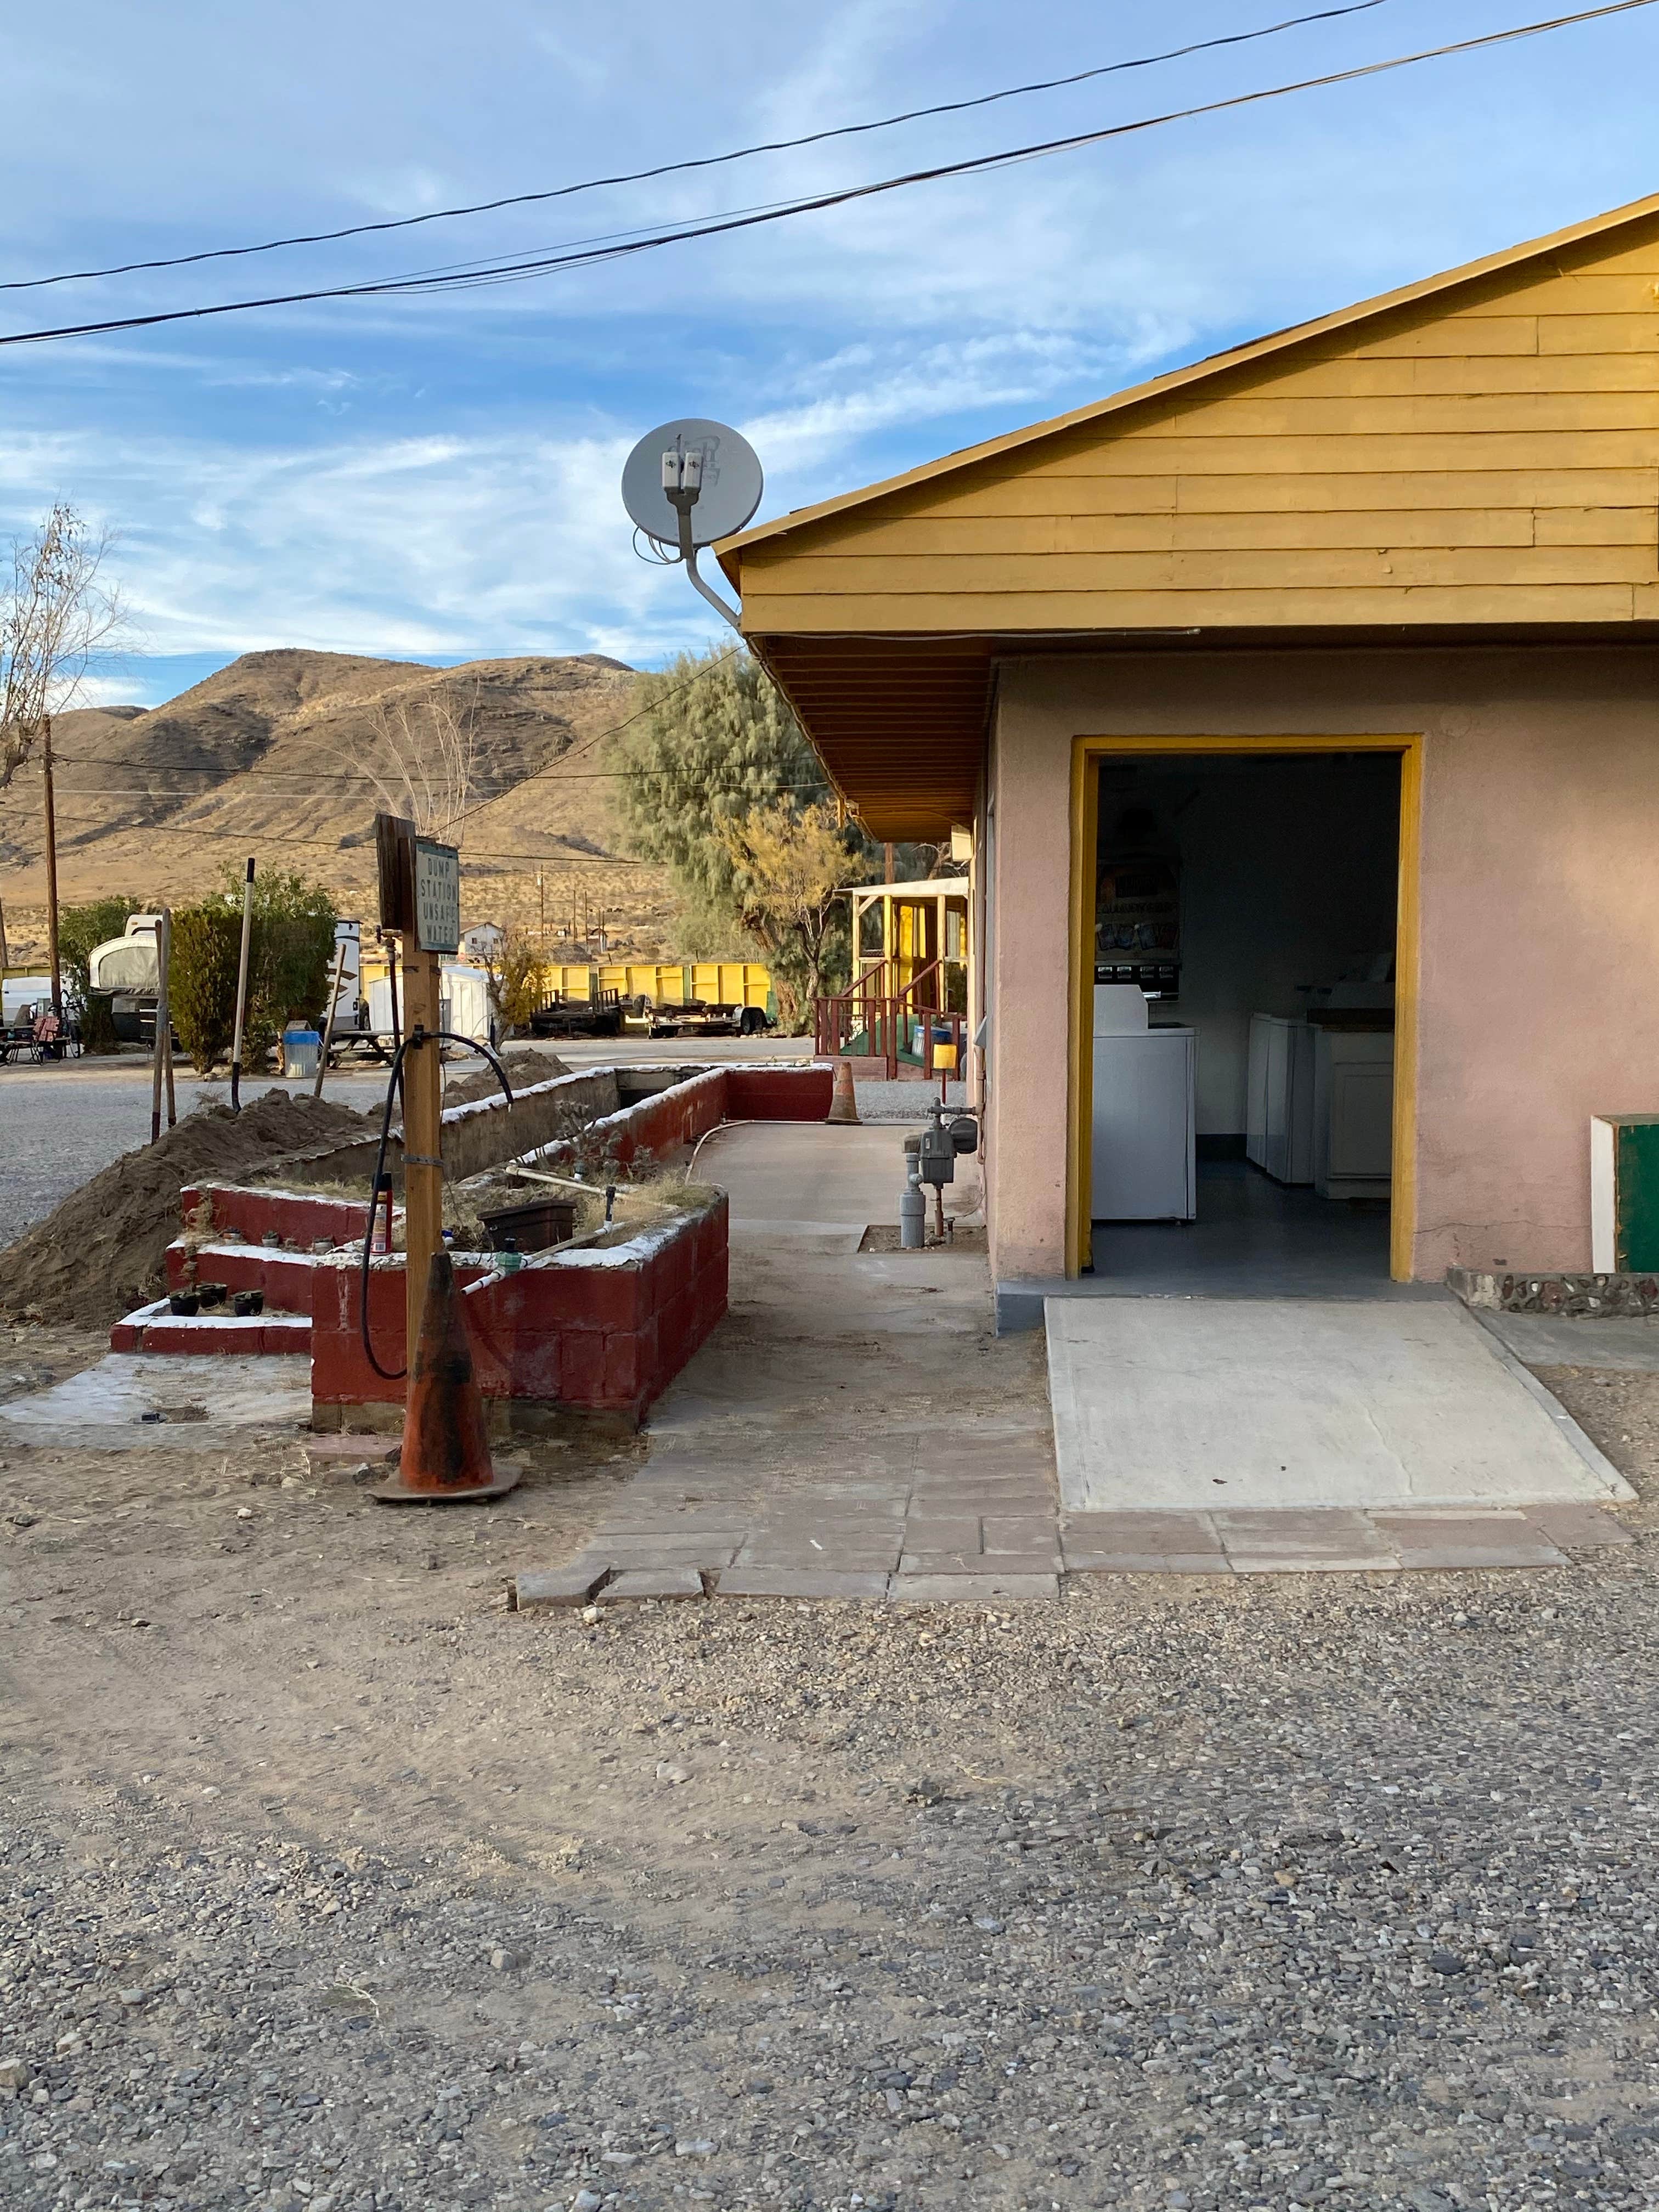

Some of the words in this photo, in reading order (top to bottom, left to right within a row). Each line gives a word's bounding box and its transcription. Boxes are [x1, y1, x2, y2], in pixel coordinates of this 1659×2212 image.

[428, 857, 449, 877] DUMP
[421, 879, 456, 903] STATION
[424, 902, 456, 923] UNSAFE
[427, 924, 454, 944] WATER
